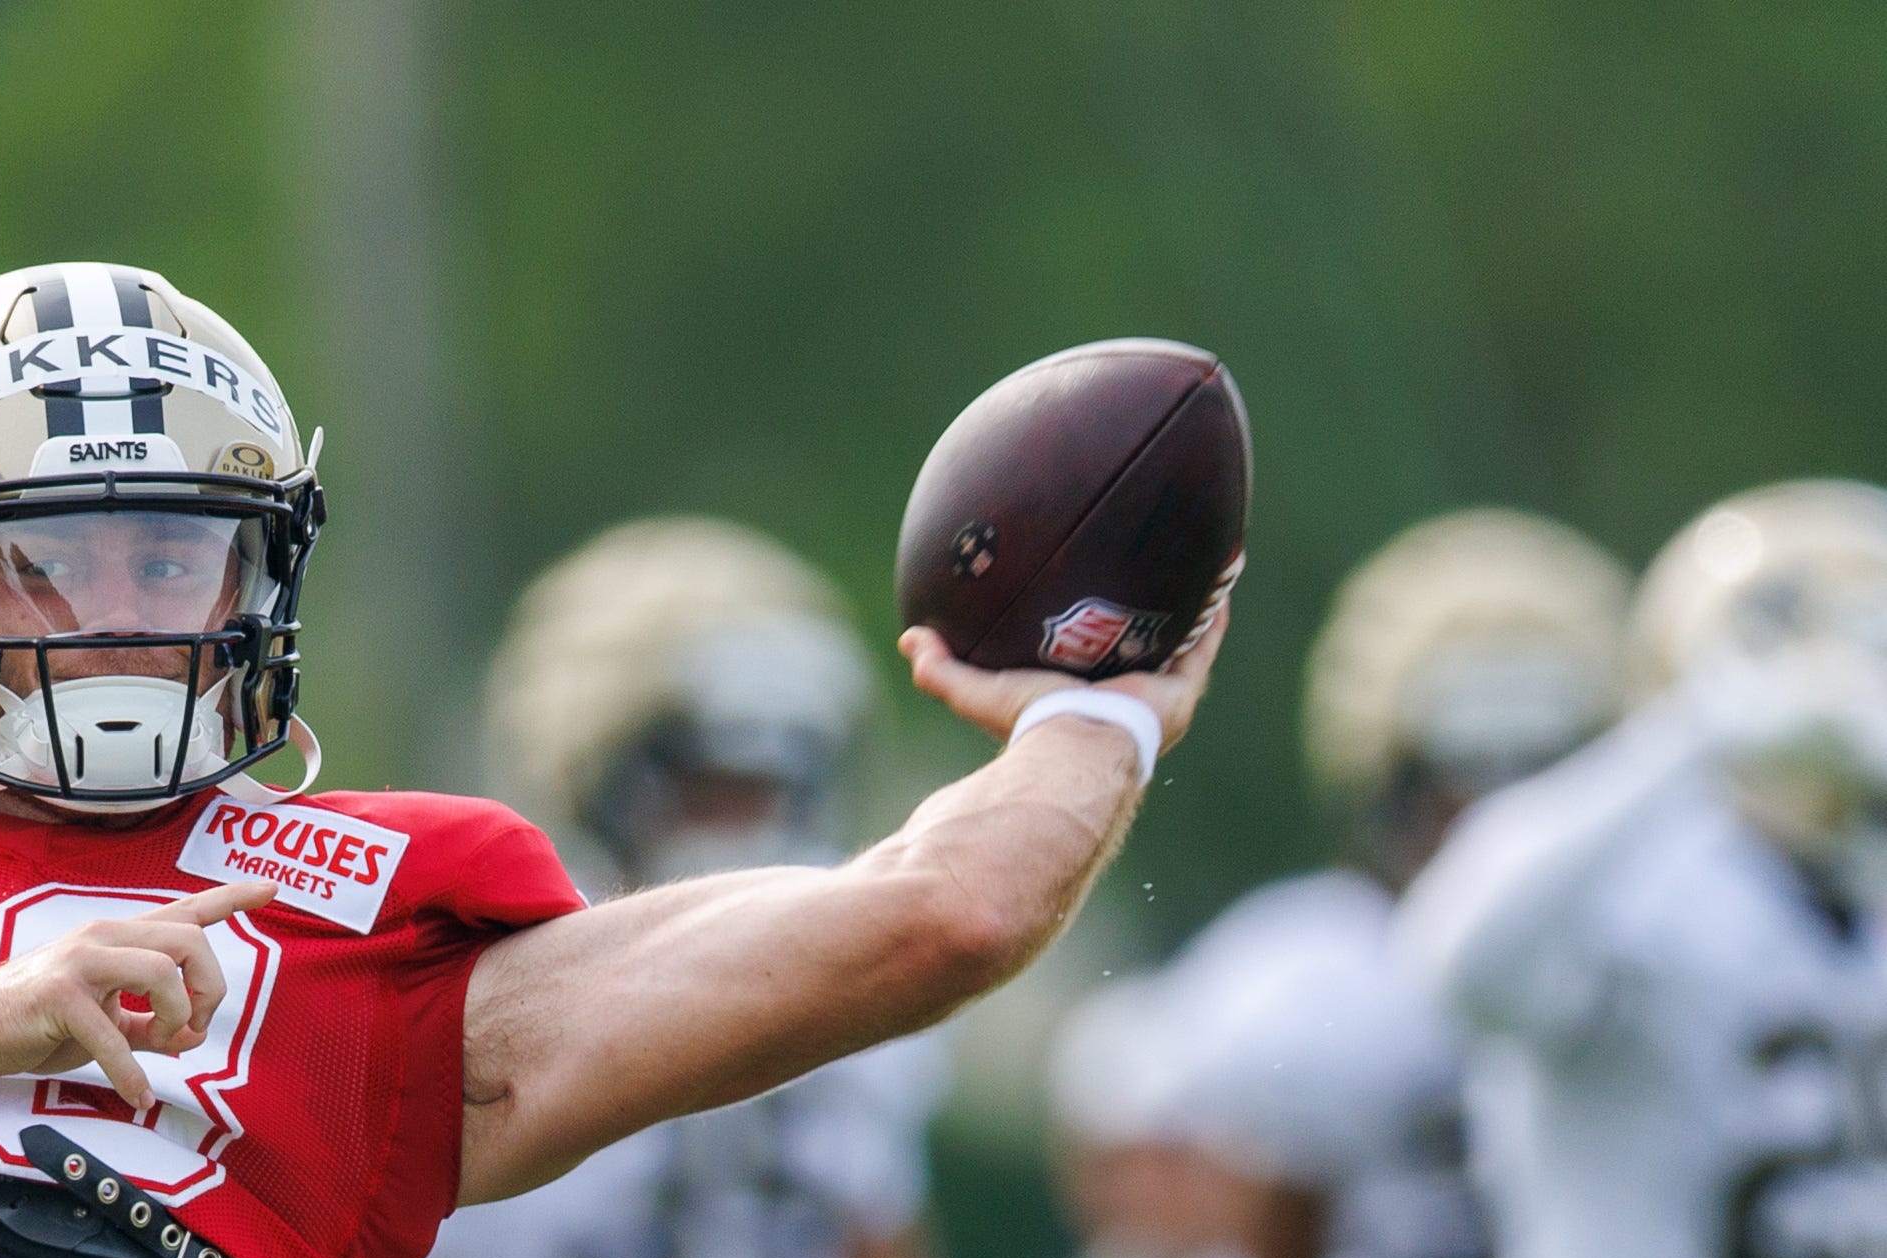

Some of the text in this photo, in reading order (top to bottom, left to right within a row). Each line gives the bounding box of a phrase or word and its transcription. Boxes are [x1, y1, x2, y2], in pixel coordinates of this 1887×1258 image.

[69, 441, 148, 463] SAINTS
[205, 803, 389, 886] ROUSES
[224, 848, 337, 900] MARKETS
